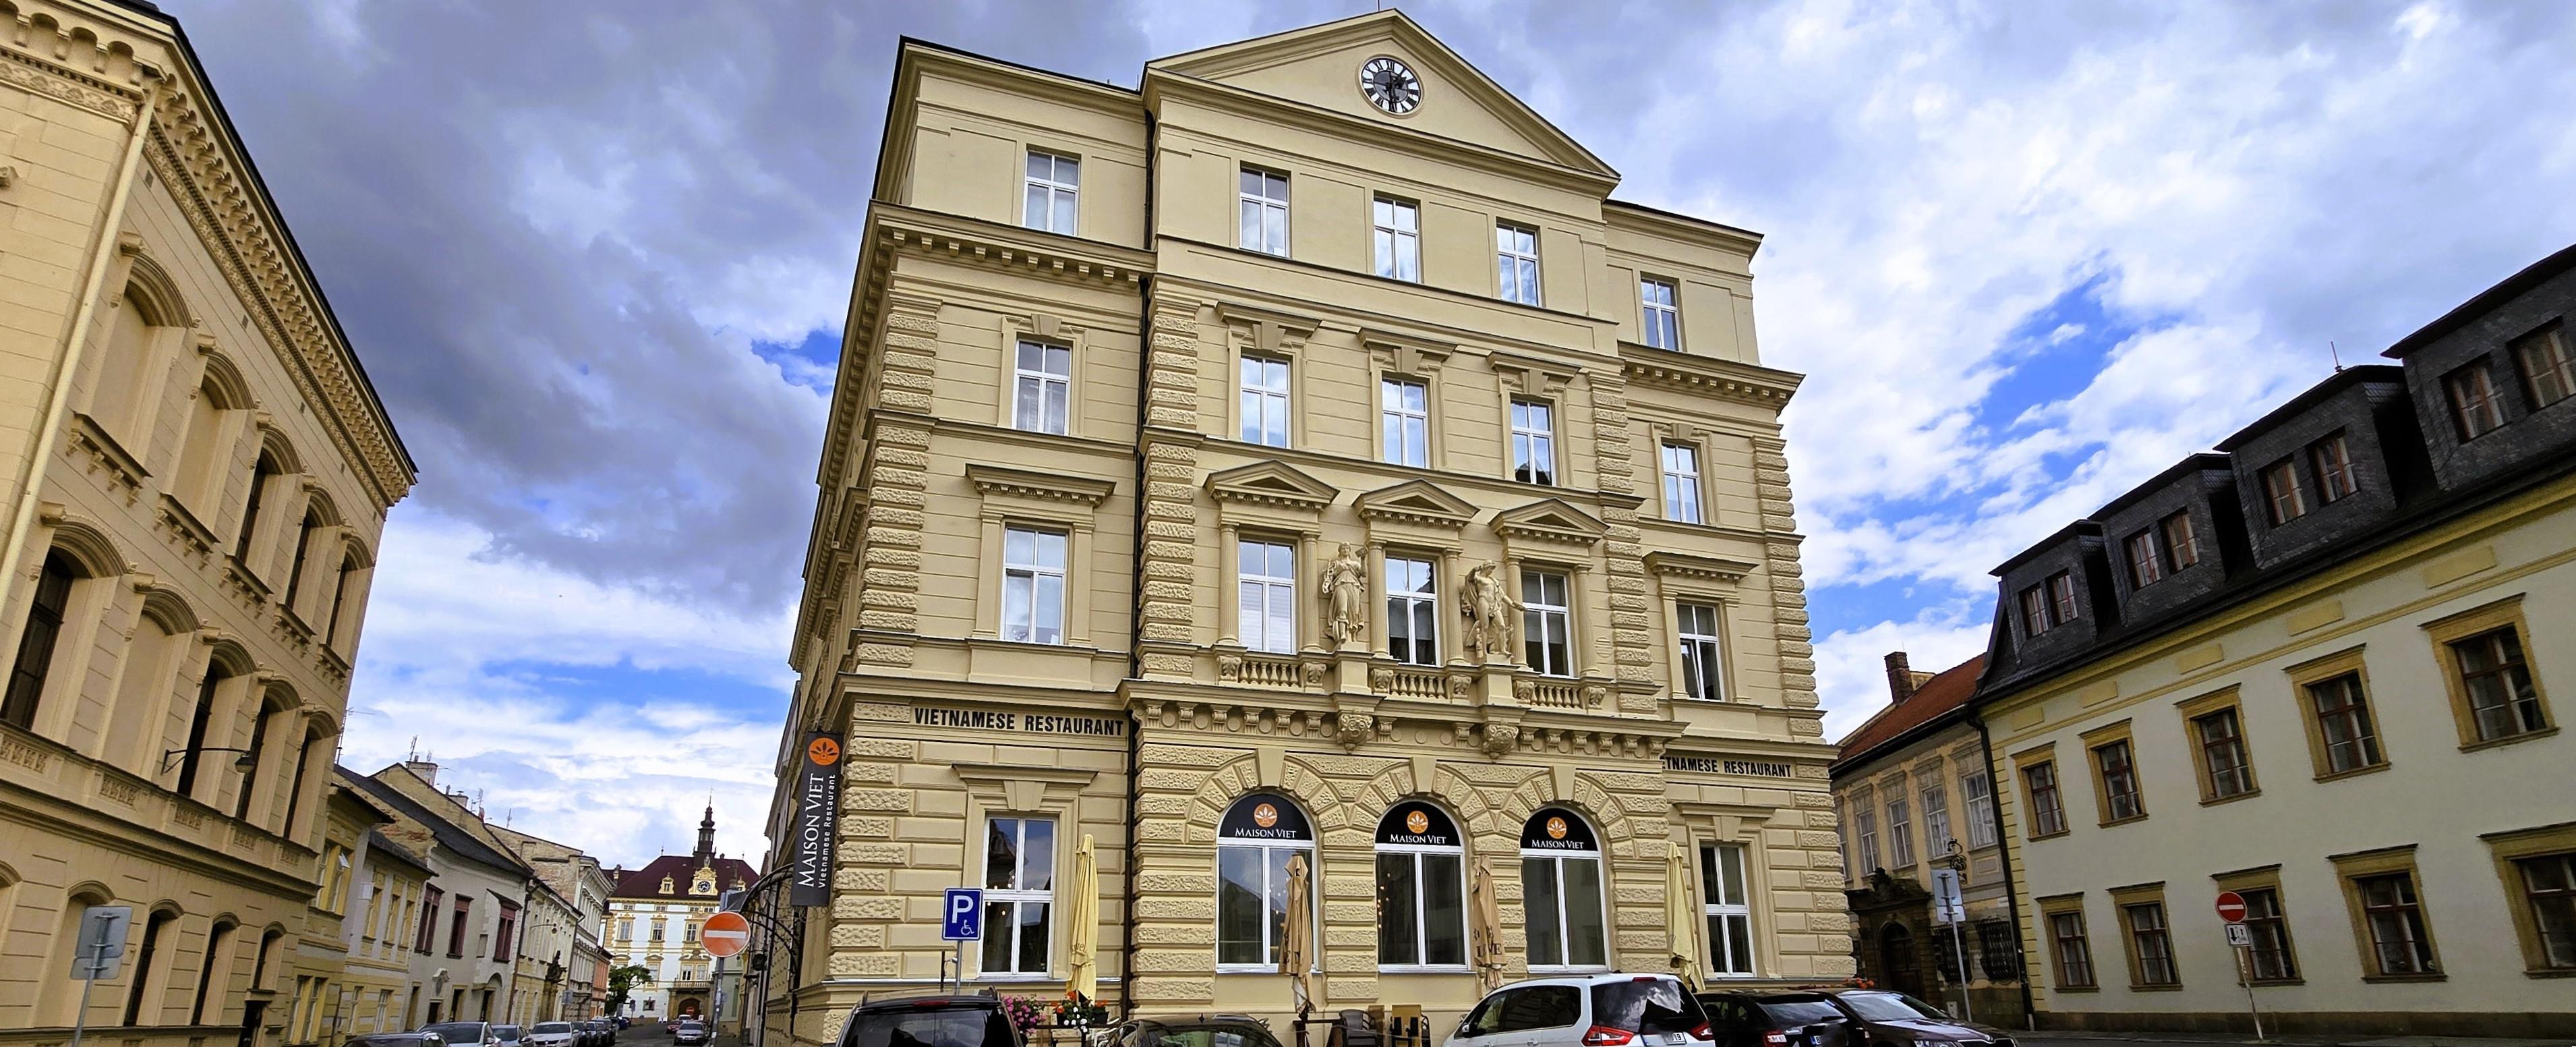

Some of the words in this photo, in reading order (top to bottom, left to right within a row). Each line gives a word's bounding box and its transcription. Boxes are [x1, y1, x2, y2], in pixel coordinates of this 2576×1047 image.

[914, 707, 1015, 729] VIETNAMESE
[1024, 714, 1123, 736] RESTAURANT
[1724, 760, 1791, 778] RESTAURANT
[805, 772, 823, 812] VIET
[823, 774, 836, 828] Restaurant
[1235, 827, 1275, 837] MAISON
[1275, 828, 1297, 839] VIET
[1390, 834, 1426, 843] MAISON
[1427, 834, 1446, 844] VIET
[1531, 839, 1565, 848] MAISON
[1565, 840, 1585, 849] VIET
[797, 814, 821, 887] MAISON
[818, 831, 831, 888] Vietnamese
[952, 895, 974, 924] P
